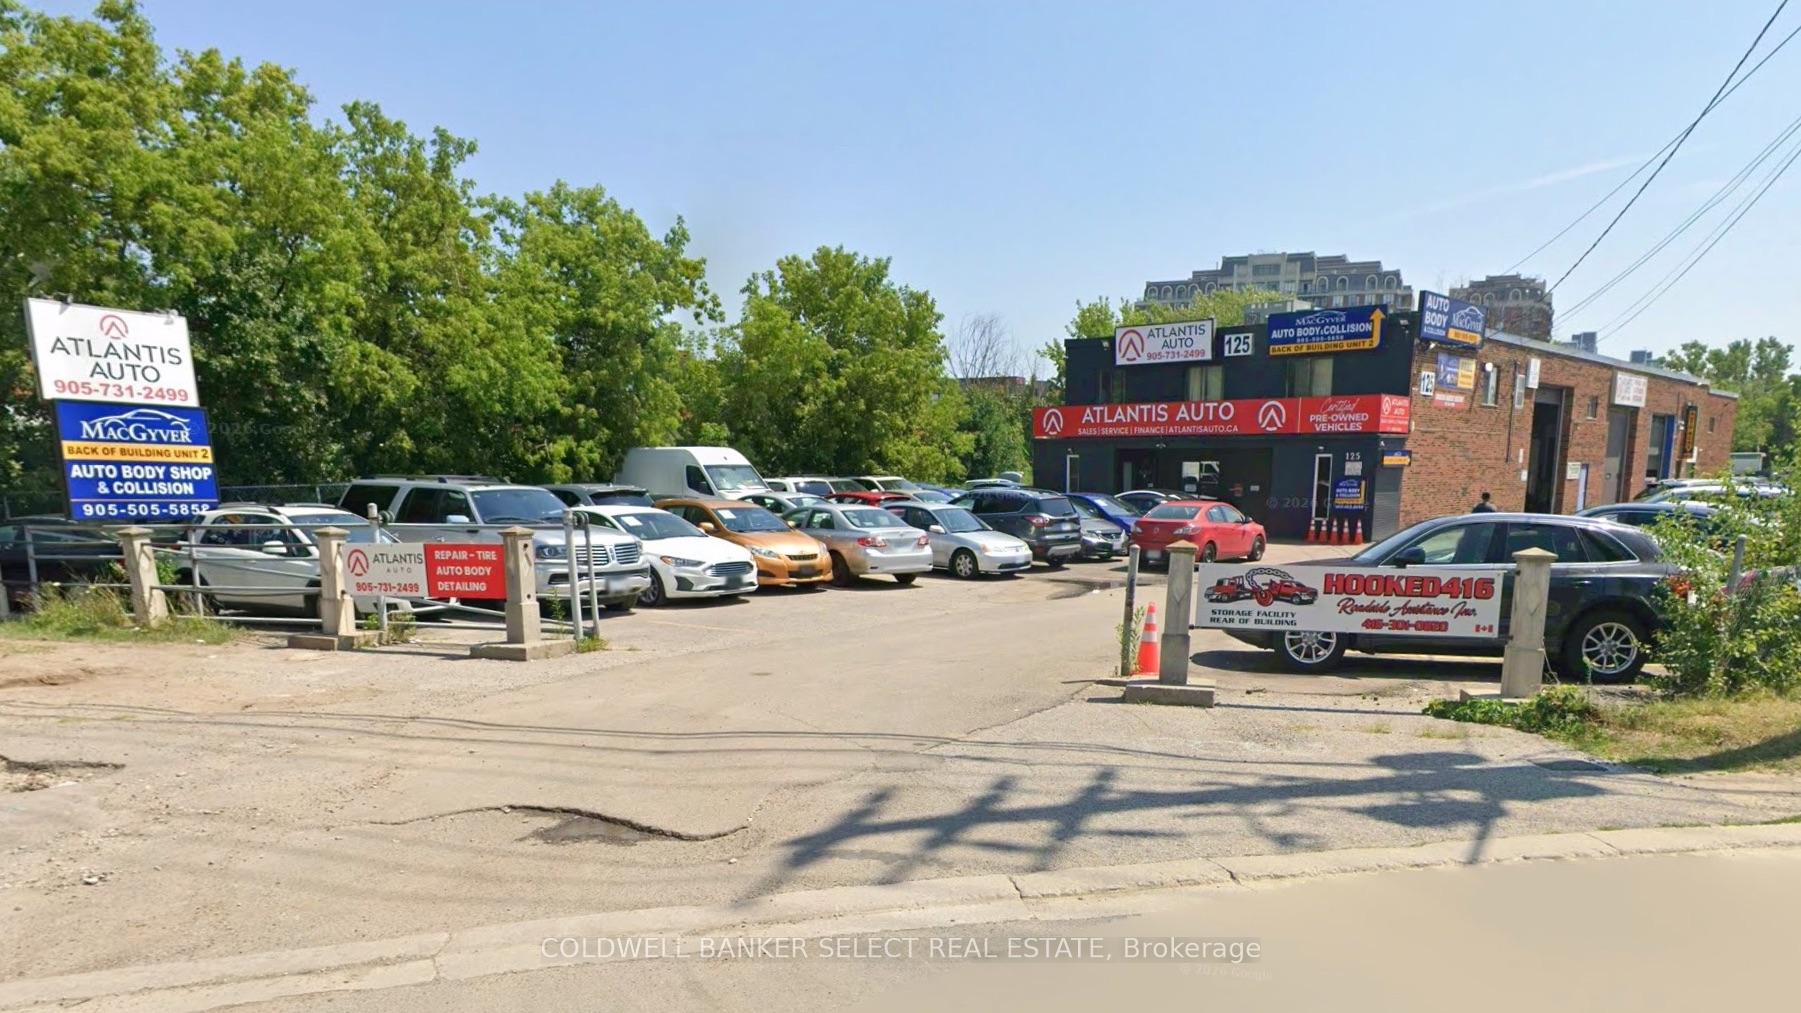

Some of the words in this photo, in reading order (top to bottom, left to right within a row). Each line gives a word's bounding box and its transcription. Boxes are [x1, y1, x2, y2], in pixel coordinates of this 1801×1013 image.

[1427, 294, 1449, 312] AUTO
[1425, 311, 1448, 328] BODY
[1147, 324, 1206, 339] ATLANTIS
[1272, 328, 1295, 339] AUTO
[1161, 338, 1194, 350] AUTO
[1225, 335, 1251, 355] 125
[1272, 344, 1292, 353] BACK
[1294, 344, 1305, 352] OF
[1306, 342, 1343, 351] BUILDING
[50, 336, 182, 365] ATLANTIS
[1146, 349, 1206, 361] 905-731-2499
[89, 361, 161, 383] AUTO
[54, 379, 188, 401] 905-731-2499
[1081, 405, 1169, 424] ATLANTIS
[1175, 402, 1235, 421] AUTO
[1309, 413, 1369, 422] PRE-OWNED
[1078, 427, 1097, 436] SALES
[1101, 426, 1129, 435] SERVICE
[1134, 425, 1164, 434] FINANCE
[1168, 424, 1239, 434] ATLANTISAUTO.CA
[1314, 422, 1362, 432] VEHICLES
[67, 445, 99, 455] BACK
[101, 446, 116, 455] OF
[119, 447, 171, 457] BUILDING
[174, 449, 198, 459] UNIT
[200, 448, 209, 459] 2
[1345, 452, 1361, 460] 125
[71, 464, 118, 479] AUTO
[121, 465, 166, 479] BODY
[169, 466, 212, 480] SHOP
[97, 481, 110, 494] &
[113, 482, 195, 495] COLLISION
[373, 553, 423, 565] ATLANTIS
[434, 550, 468, 561] REPAIR
[476, 551, 498, 561] TIRE
[436, 566, 463, 576] AUTO
[464, 566, 492, 576] BODY
[356, 582, 420, 593] 905-731-2499
[437, 581, 487, 592] DETAILING
[1323, 573, 1496, 600] HOOKED416
[1337, 597, 1391, 616] Roadside
[1388, 600, 1449, 617] Assistance
[1211, 609, 1252, 617] STORAGE
[1257, 610, 1297, 618] FACILITY
[1254, 618, 1297, 626] BUILDING
